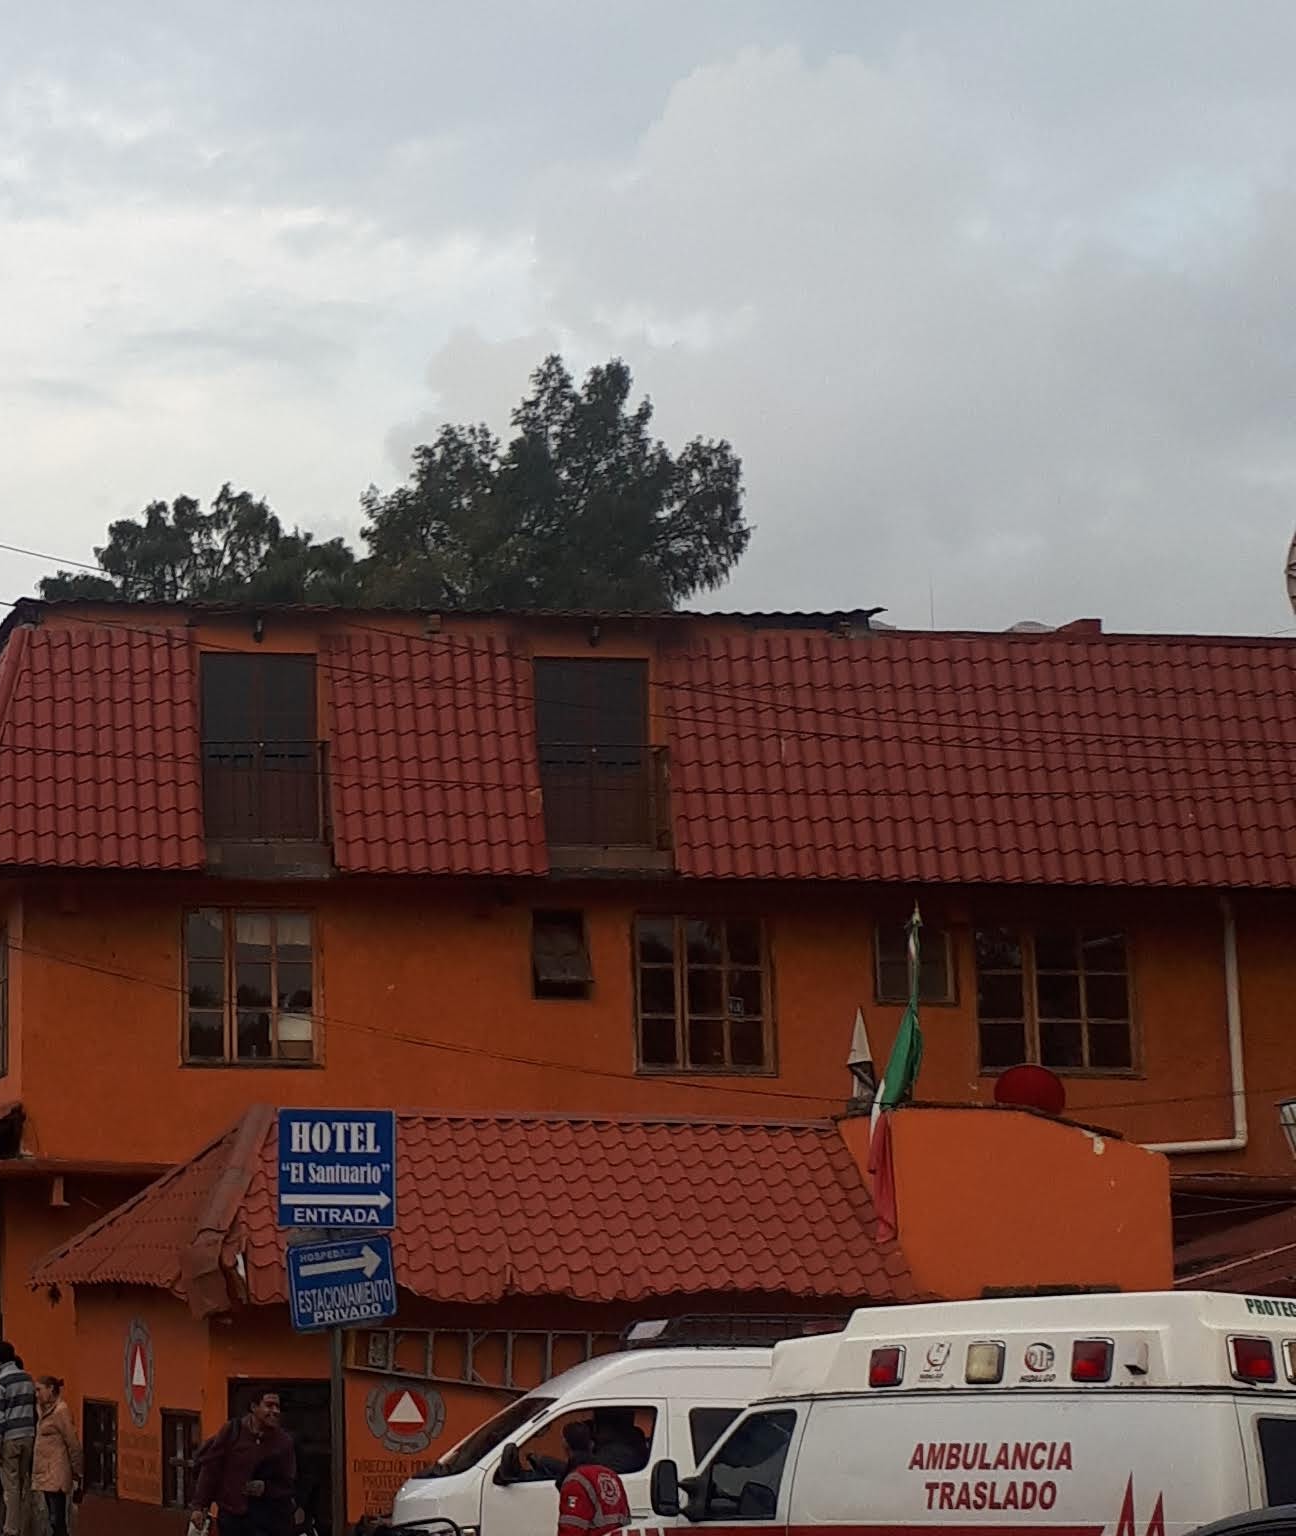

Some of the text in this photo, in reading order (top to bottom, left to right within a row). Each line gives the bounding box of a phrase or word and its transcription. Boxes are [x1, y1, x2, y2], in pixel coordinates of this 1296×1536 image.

[290, 1121, 381, 1153] HOTEL
[293, 1207, 380, 1223] ENTRADA
[297, 1279, 391, 1313] ESTACIONAMIENTO
[313, 1303, 382, 1324] PRIVADO
[908, 1441, 1073, 1470] AMBULANCIA
[925, 1480, 1057, 1510] TRASLADO
